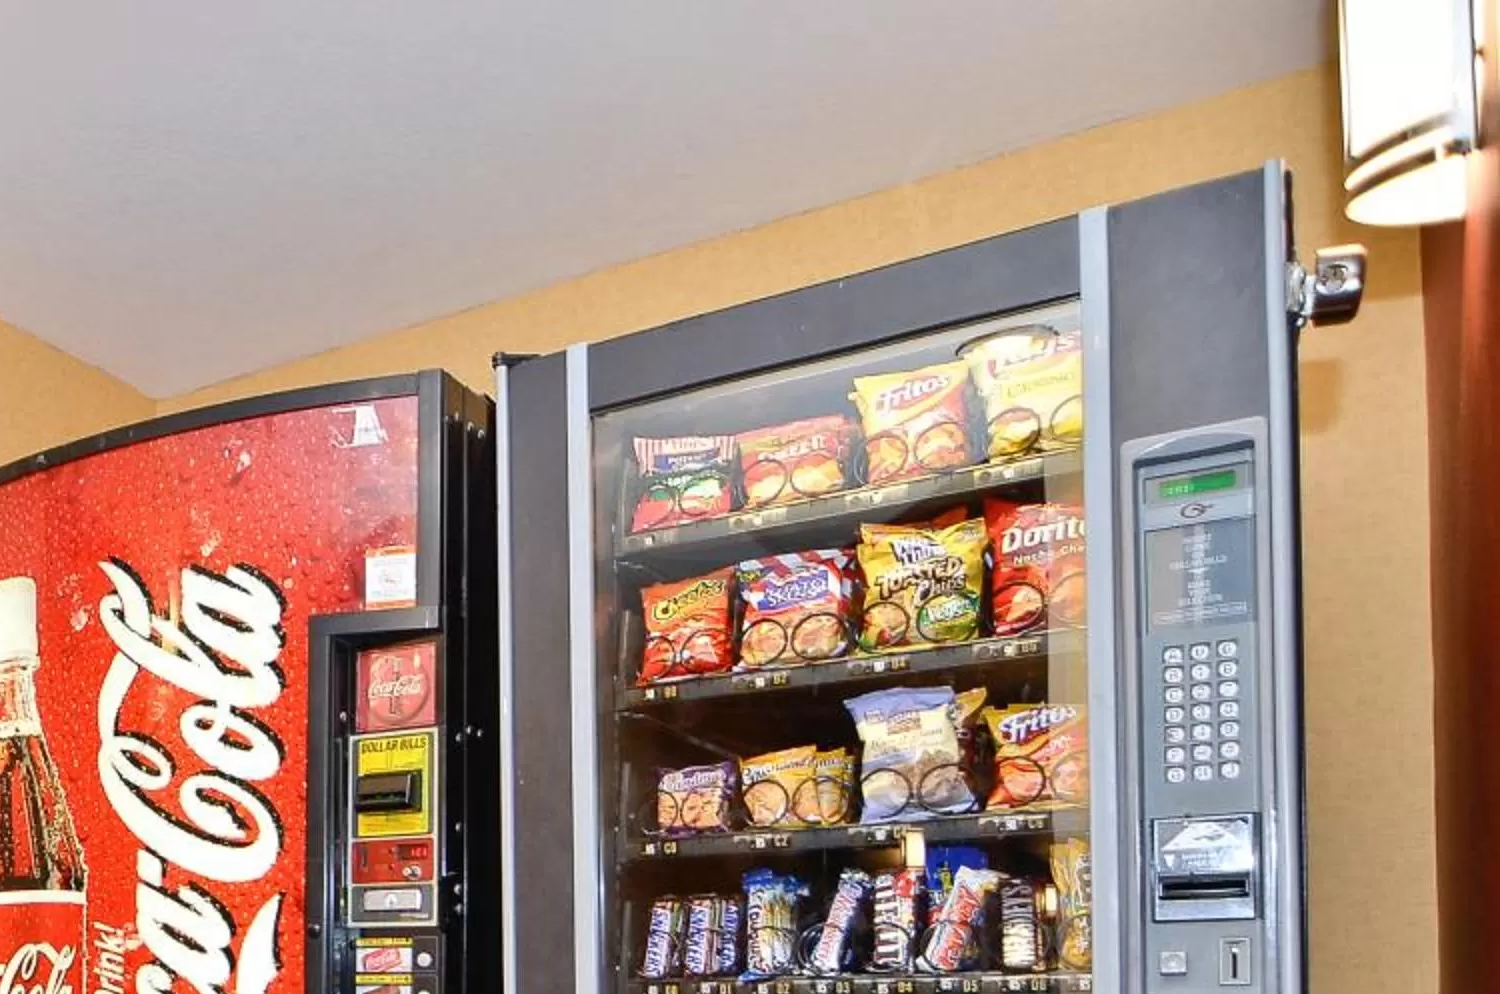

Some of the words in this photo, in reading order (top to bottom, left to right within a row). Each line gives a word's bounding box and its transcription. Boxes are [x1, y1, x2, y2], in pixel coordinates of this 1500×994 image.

[876, 375, 951, 415] Fritos
[998, 704, 1077, 744] Fritos
[361, 740, 398, 754] DOLLAR
[399, 737, 427, 751] BILLS
